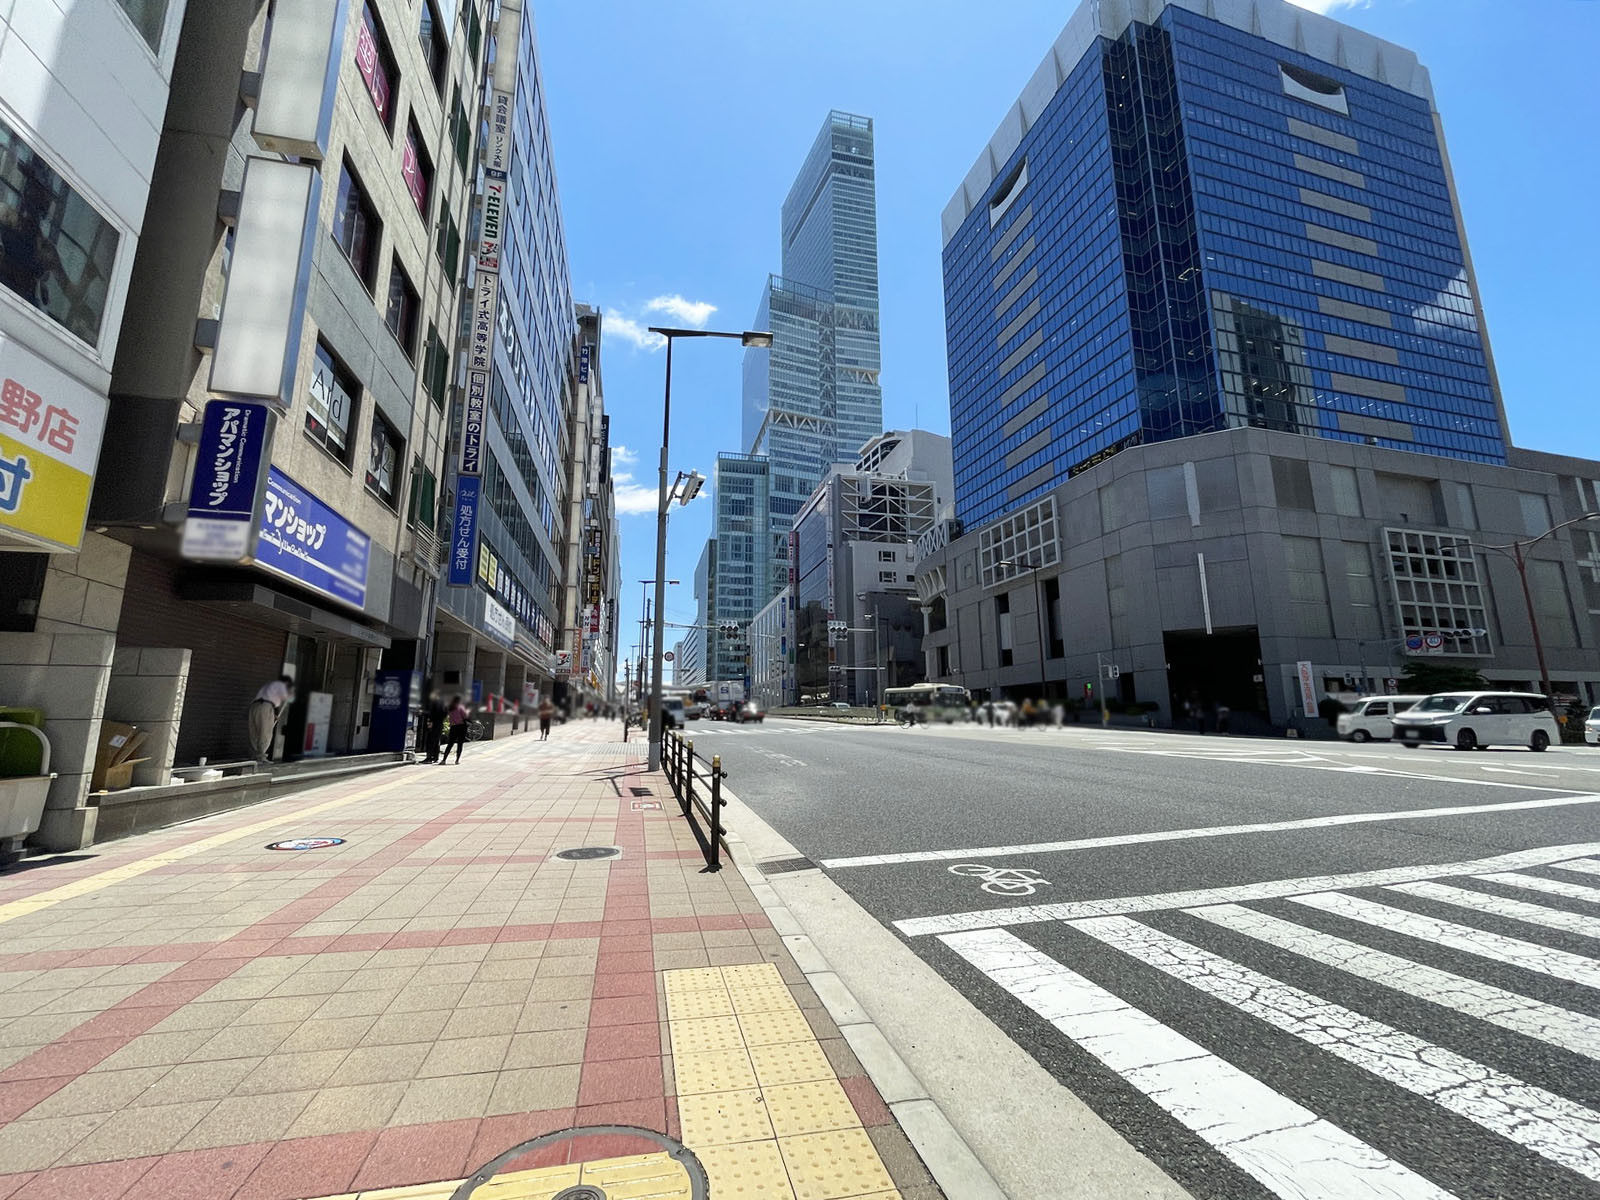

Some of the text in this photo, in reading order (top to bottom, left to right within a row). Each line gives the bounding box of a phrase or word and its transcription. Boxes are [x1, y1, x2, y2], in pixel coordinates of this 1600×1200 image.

[496, 95, 508, 134] 貸会議室
[473, 276, 491, 367] トライ式高等学院
[0, 378, 80, 454] 野店
[233, 409, 252, 484] Dramatic Communication
[465, 373, 485, 471] 個別教室のトライ
[209, 407, 241, 506] アパマンショップ
[265, 490, 327, 551] マンショップ
[455, 504, 473, 570] 処方せん受付
